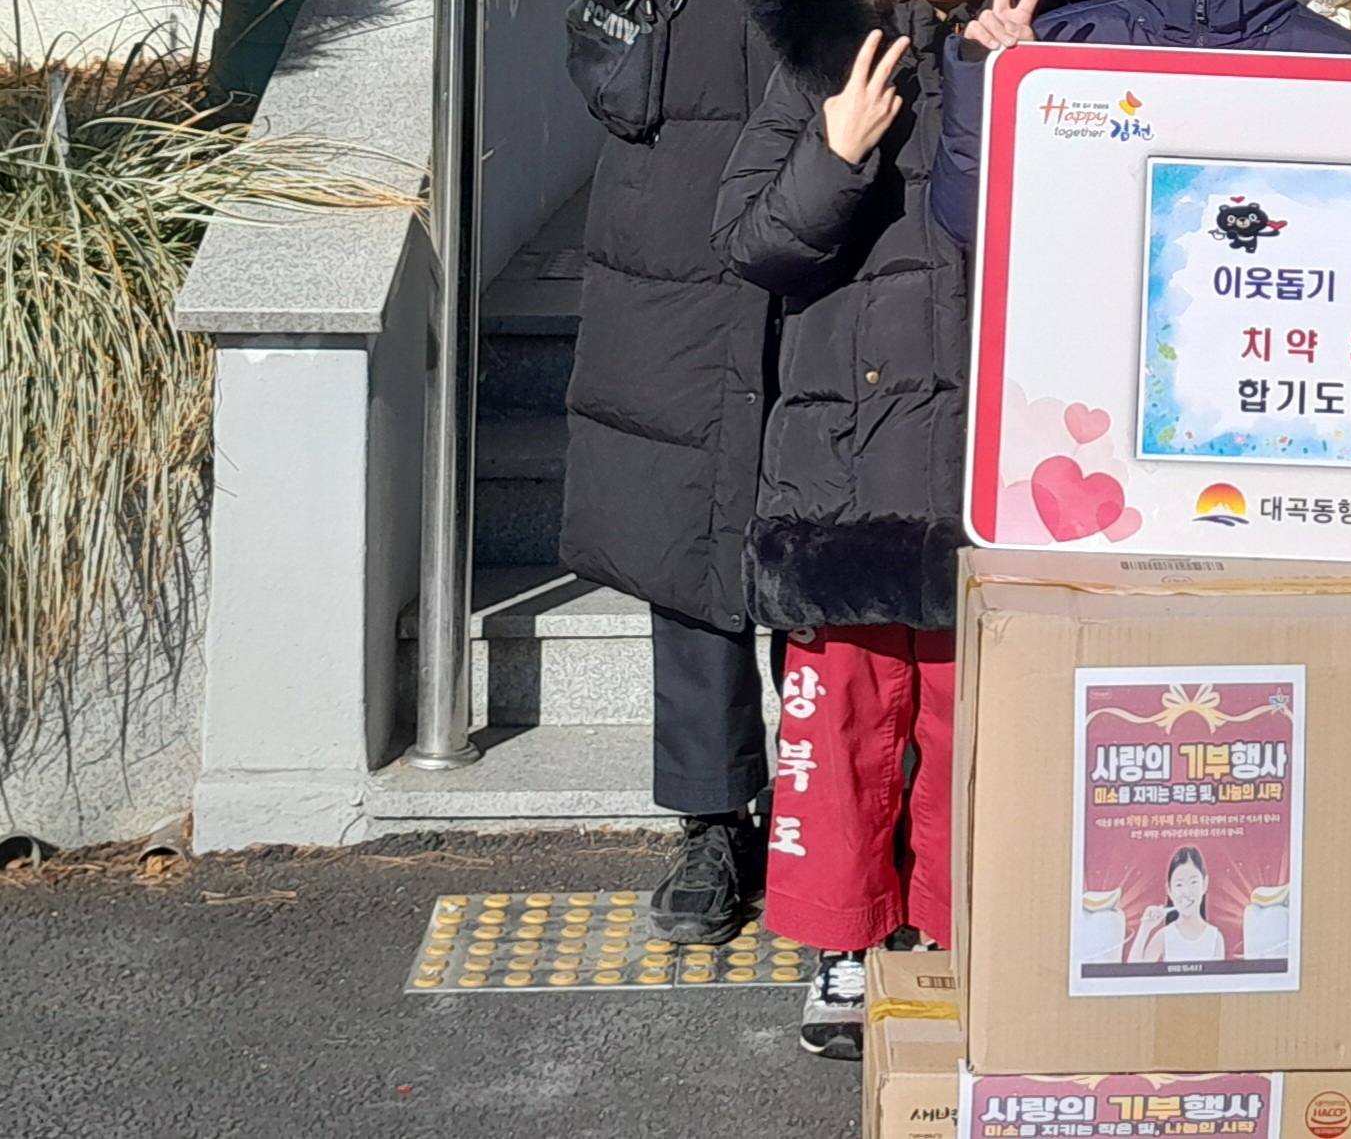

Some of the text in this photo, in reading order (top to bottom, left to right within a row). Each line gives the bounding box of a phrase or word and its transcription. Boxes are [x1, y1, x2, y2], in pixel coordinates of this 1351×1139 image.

[1039, 94, 1109, 127] Happy
[1054, 126, 1105, 139] together
[1110, 118, 1154, 142] 김천
[1213, 266, 1335, 303] 이웃돕기
[1091, 741, 1287, 782] 사랑의 기부행사
[1094, 785, 1130, 804] 미소를
[1133, 785, 1170, 803] 지키는
[1172, 784, 1197, 802] 작은
[1218, 783, 1254, 801] 나눔의
[1257, 783, 1282, 800] 시작
[980, 1093, 1263, 1123] 사랑의 기부행사
[1313, 1108, 1346, 1117] HACCP
[1042, 1124, 1093, 1137] 지키는
[1098, 1123, 1133, 1136] 작은
[1220, 1122, 1254, 1134] 시작
